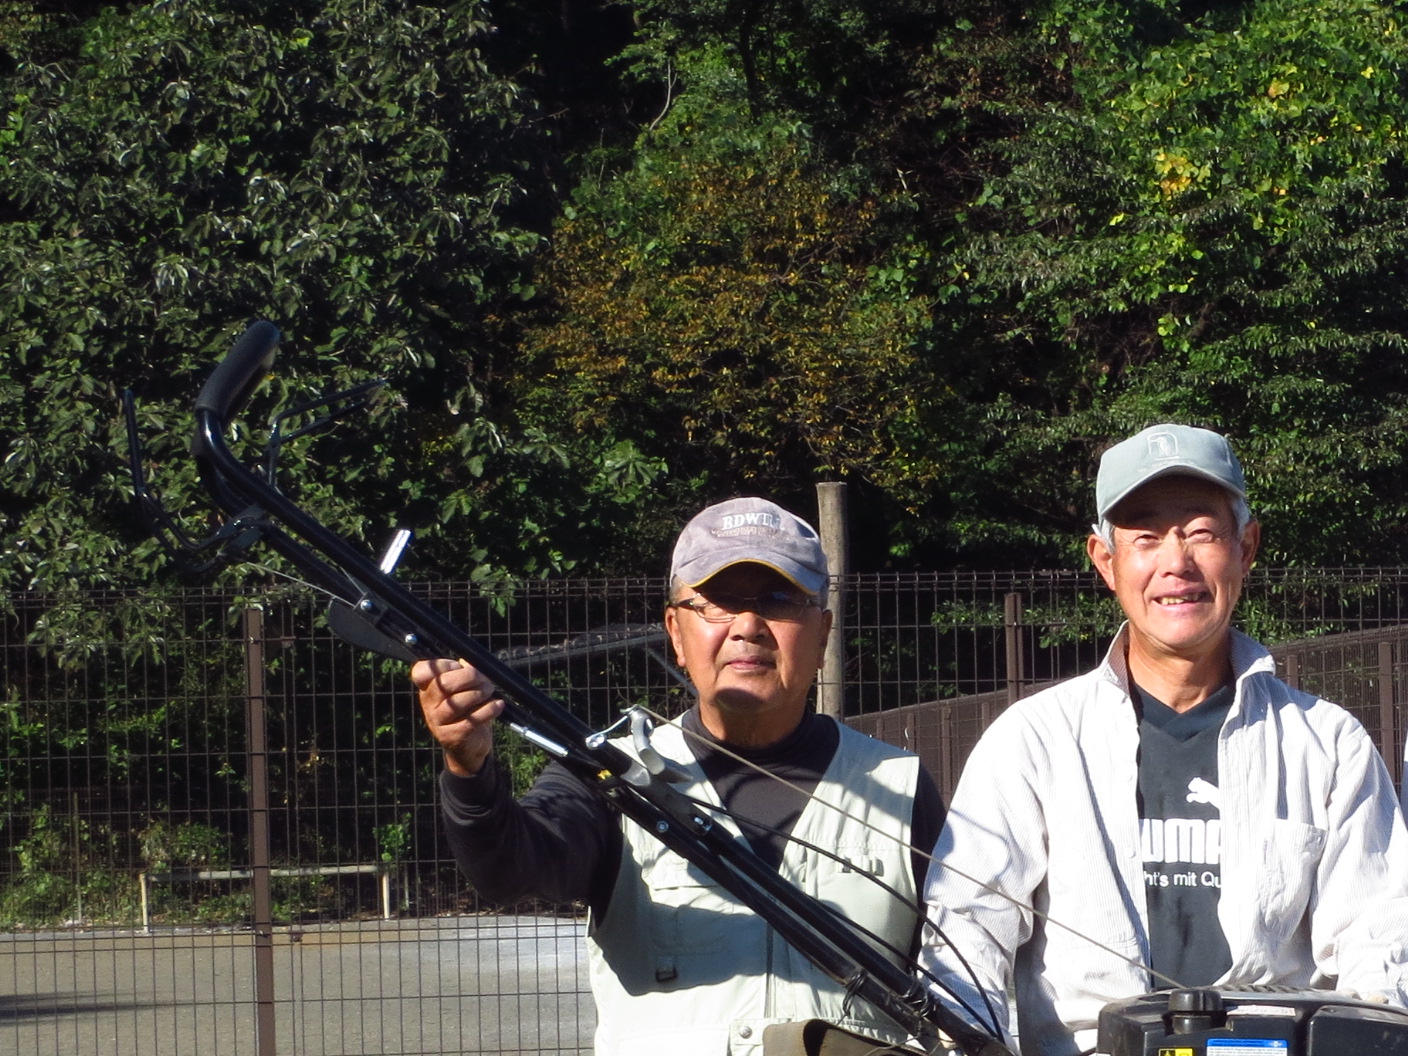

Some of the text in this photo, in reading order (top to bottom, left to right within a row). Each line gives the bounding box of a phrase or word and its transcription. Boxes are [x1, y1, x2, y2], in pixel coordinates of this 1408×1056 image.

[1141, 818, 1222, 865] UMA
[1144, 870, 1222, 889] ht's mit Qu
